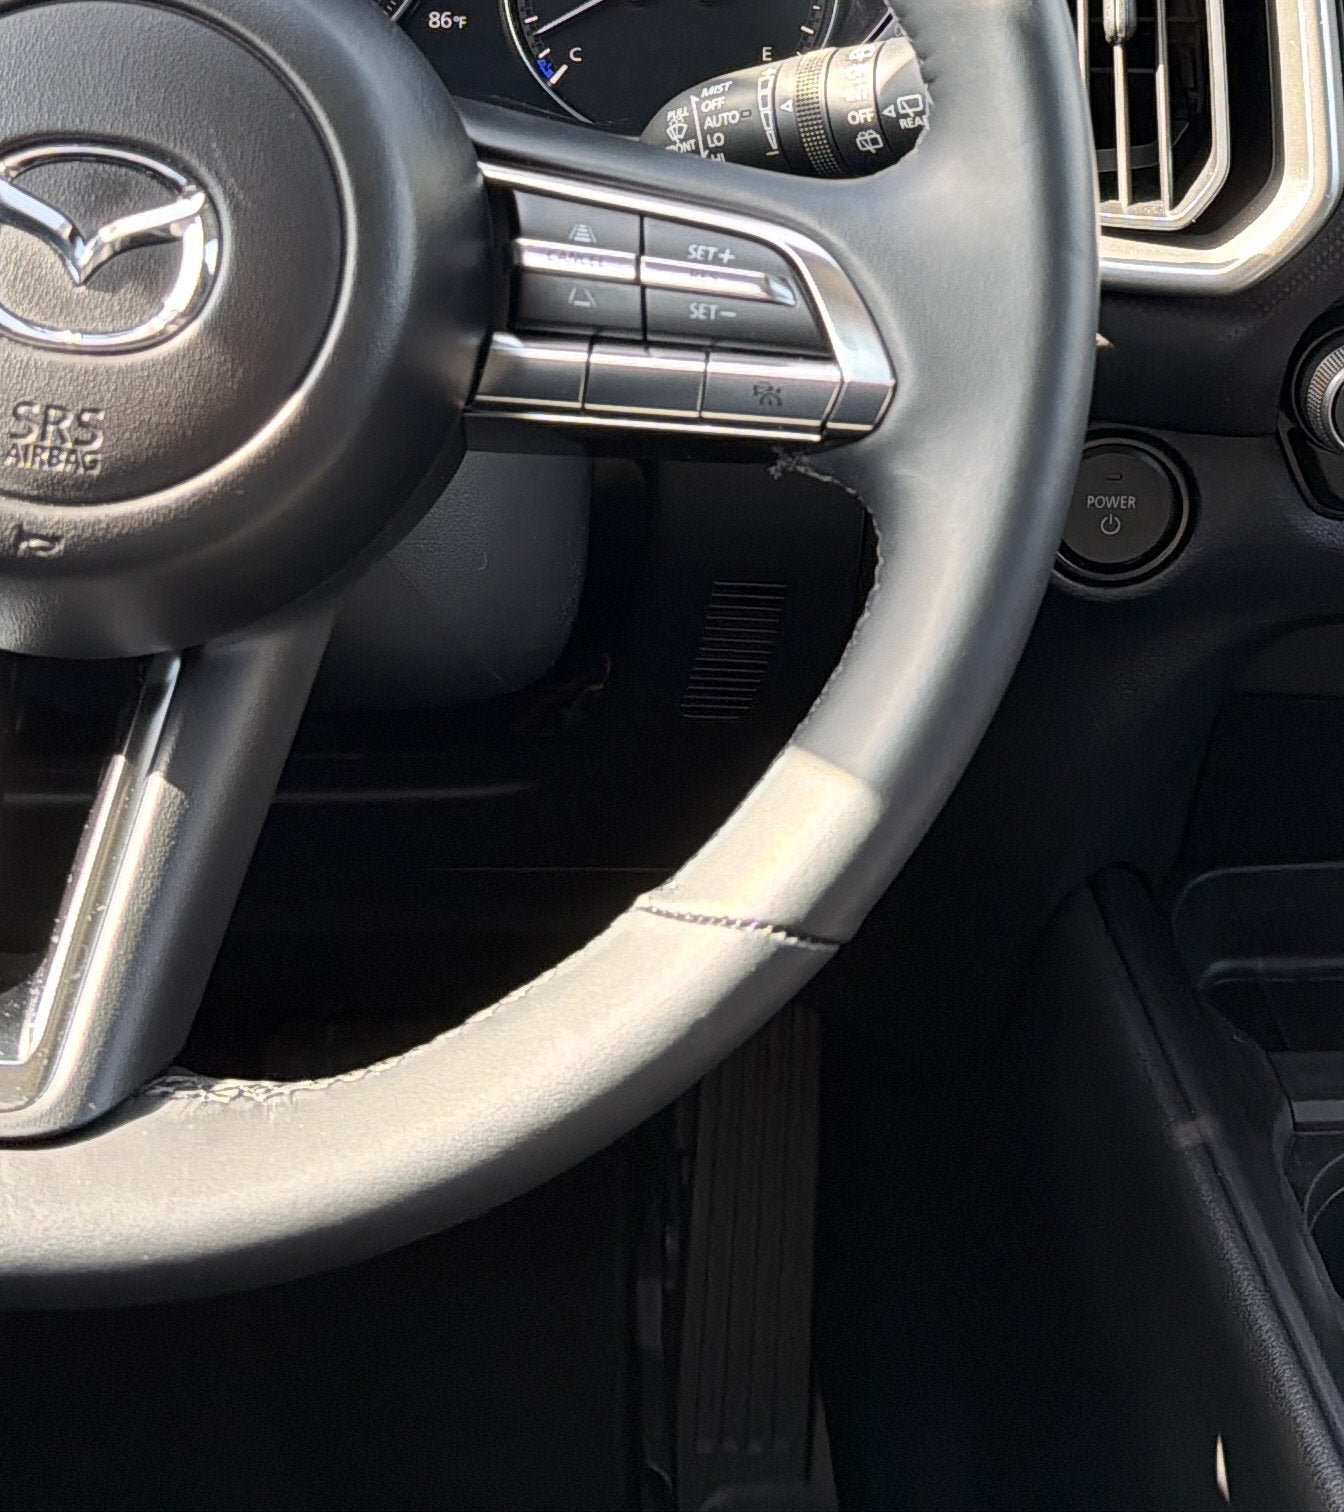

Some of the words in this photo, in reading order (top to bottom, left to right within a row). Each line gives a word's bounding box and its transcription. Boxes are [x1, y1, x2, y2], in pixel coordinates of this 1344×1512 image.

[569, 46, 582, 63] C
[762, 46, 773, 62] E
[700, 80, 734, 99] MIST
[666, 106, 690, 122] PULL
[700, 99, 726, 114] OFF
[703, 110, 740, 131] AUTO
[847, 107, 875, 125] OFF
[706, 131, 725, 148] LO
[9, 399, 106, 448] SRS
[3, 443, 105, 476] AIRBAG
[1086, 495, 1136, 509] POWER
